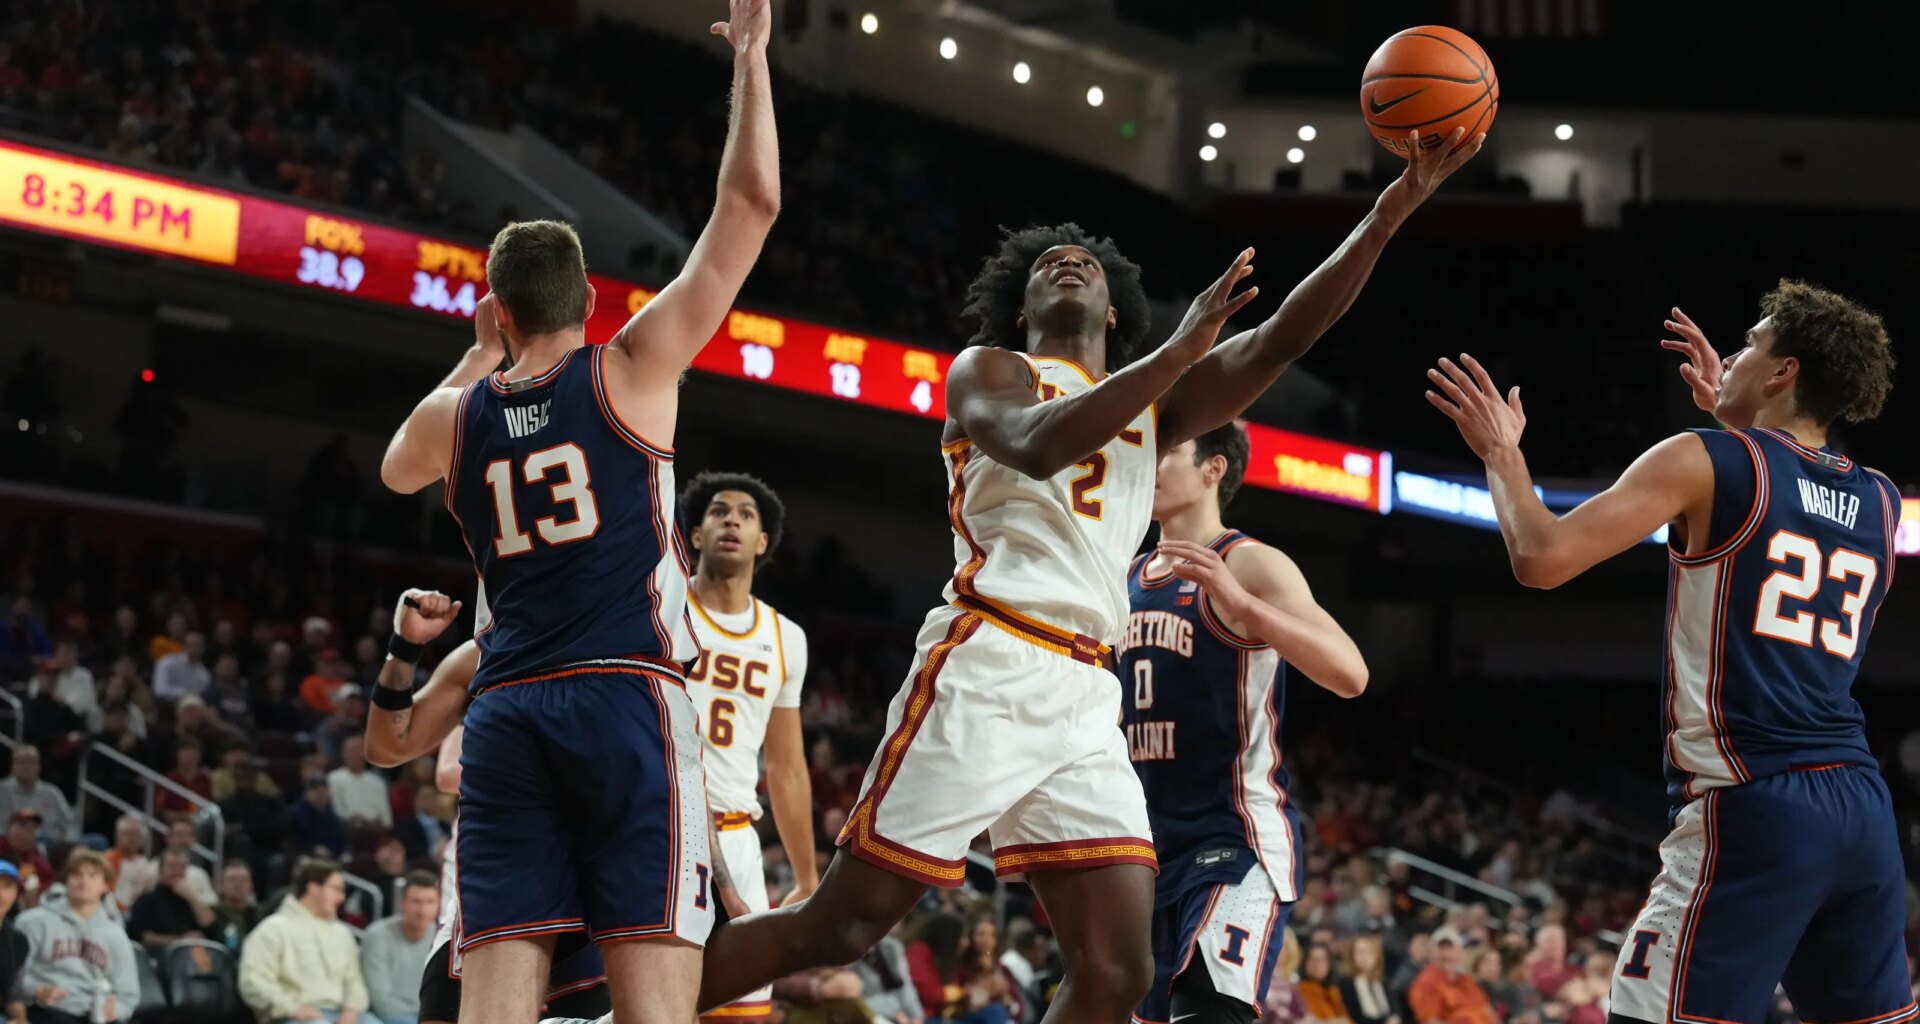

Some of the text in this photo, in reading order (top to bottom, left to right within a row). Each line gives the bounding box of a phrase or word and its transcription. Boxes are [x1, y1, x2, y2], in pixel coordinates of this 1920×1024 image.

[21, 174, 192, 240] 8:34 PM
[296, 246, 365, 292] 38.9
[410, 270, 476, 317] 36.4
[829, 362, 860, 398] 12
[910, 380, 932, 413] 4
[484, 441, 600, 559] 13
[1070, 450, 1109, 522] 2
[1797, 477, 1860, 530] WAGLER
[1752, 529, 1877, 660] 23
[1076, 643, 1098, 657] TROJANS
[1116, 610, 1194, 664] GHTING
[1134, 658, 1153, 710] 0
[708, 697, 736, 747] 6
[1127, 721, 1176, 762] LLINI
[1219, 922, 1250, 968] I
[1621, 929, 1661, 980] I
